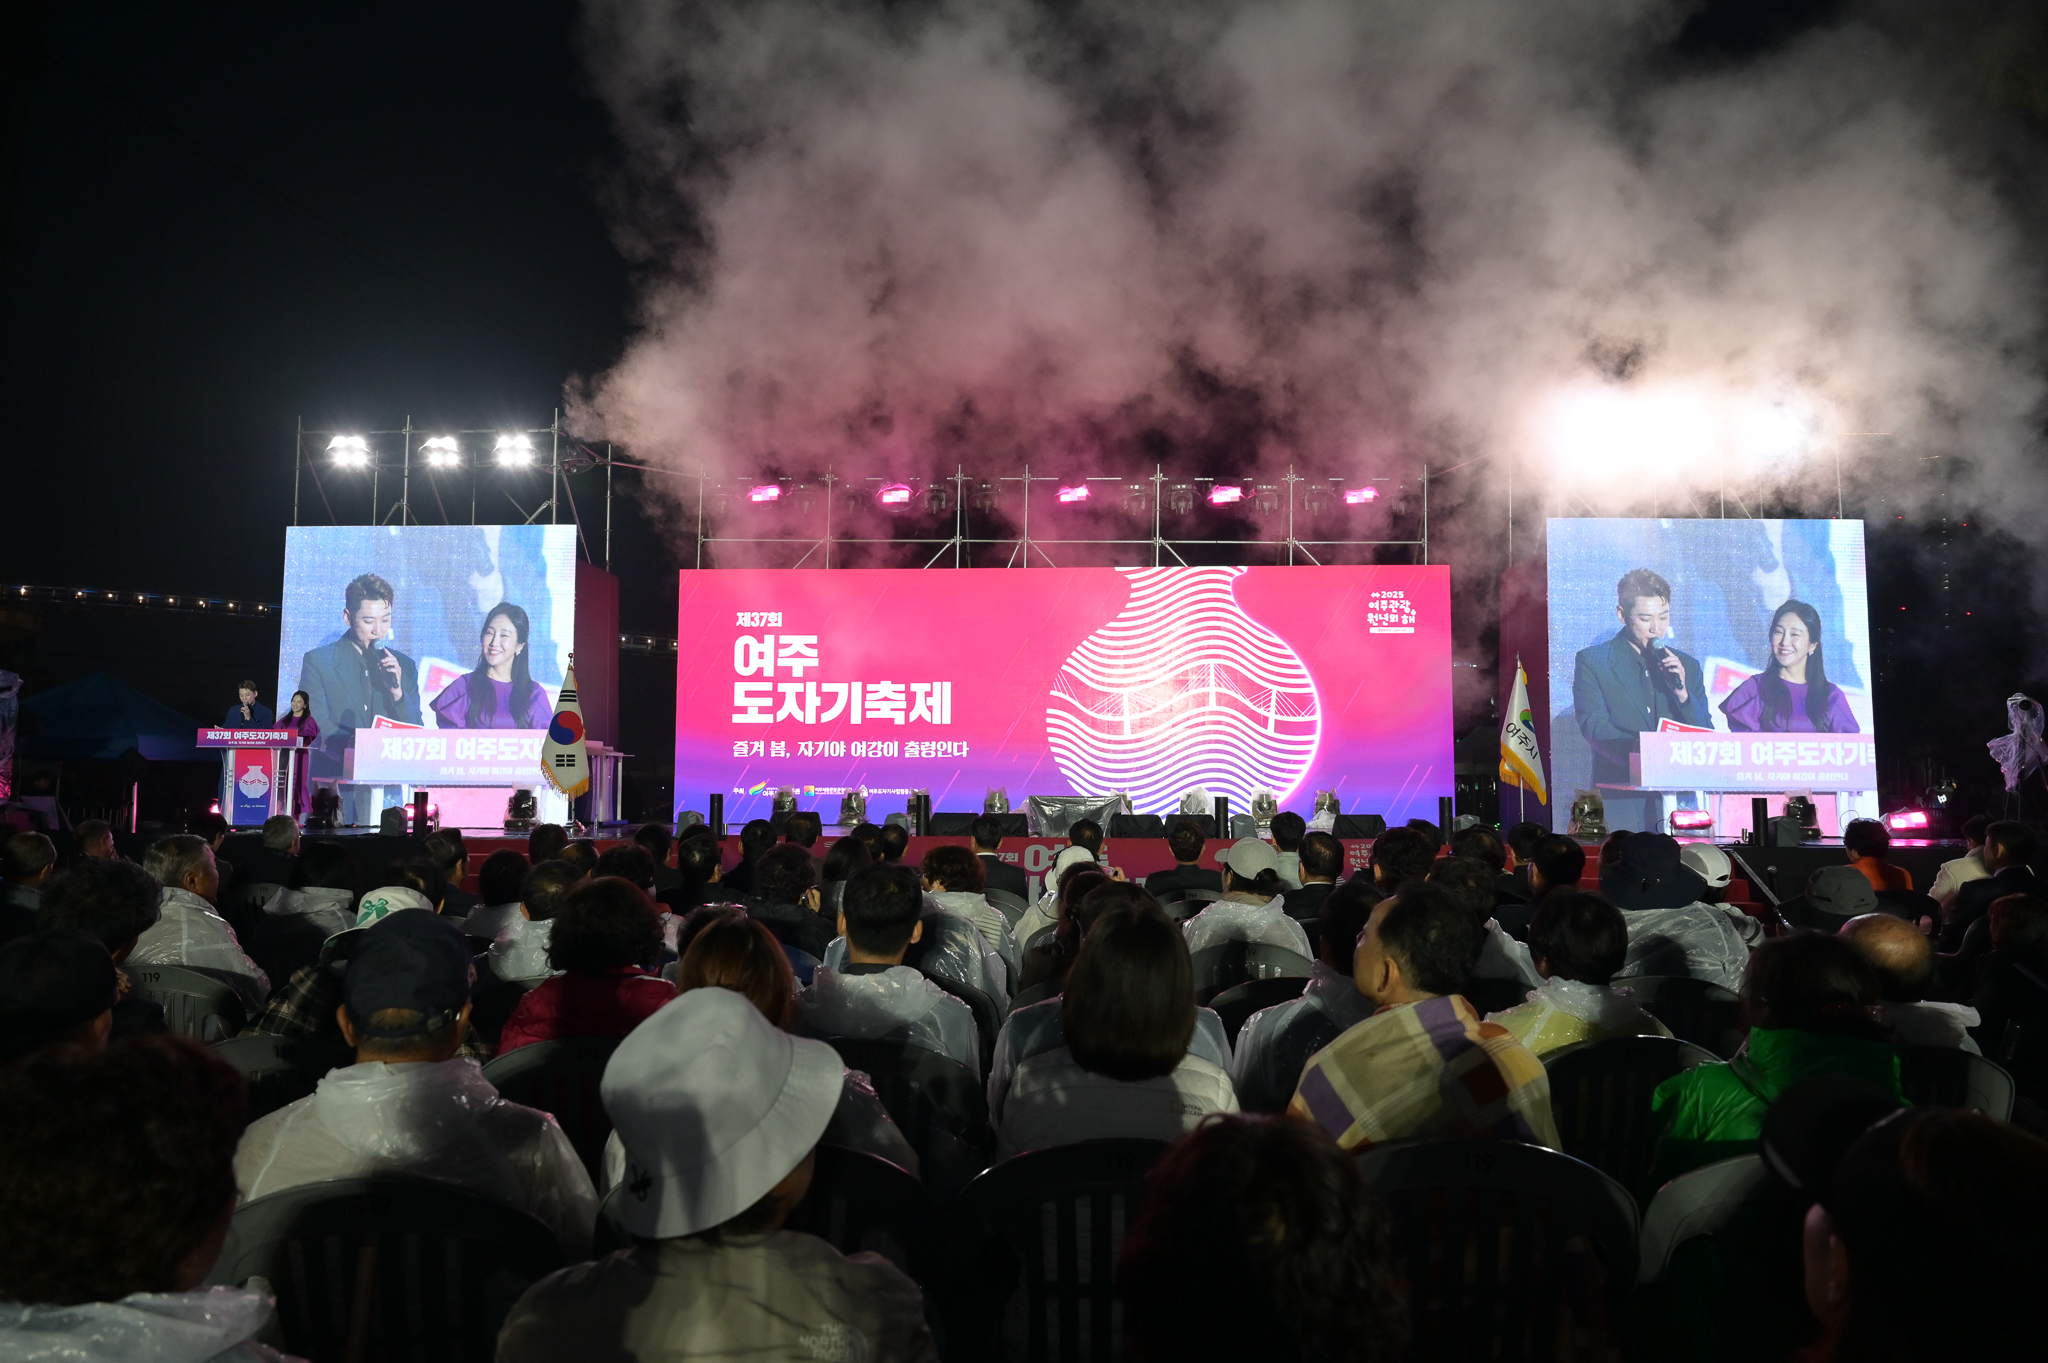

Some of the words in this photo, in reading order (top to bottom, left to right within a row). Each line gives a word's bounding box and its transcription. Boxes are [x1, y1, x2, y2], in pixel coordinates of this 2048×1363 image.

[1381, 591, 1404, 599] 2025
[736, 612, 782, 627] 제37회
[1401, 614, 1415, 625] 해
[734, 634, 819, 677] 여주
[732, 681, 951, 725] 도자기축제
[207, 731, 231, 740] 제37회
[234, 731, 288, 740] 여주도자기축제
[1506, 722, 1538, 760] 여주시
[380, 737, 447, 761] 제37회
[455, 737, 543, 761] 여주도자
[733, 741, 765, 757] 즐겨
[770, 741, 790, 758] 봄,
[797, 741, 846, 757] 자기야
[851, 741, 898, 757] 여강이
[904, 741, 969, 758] 출렁인다
[1670, 741, 1742, 766] 제37회
[142, 972, 160, 982] 119
